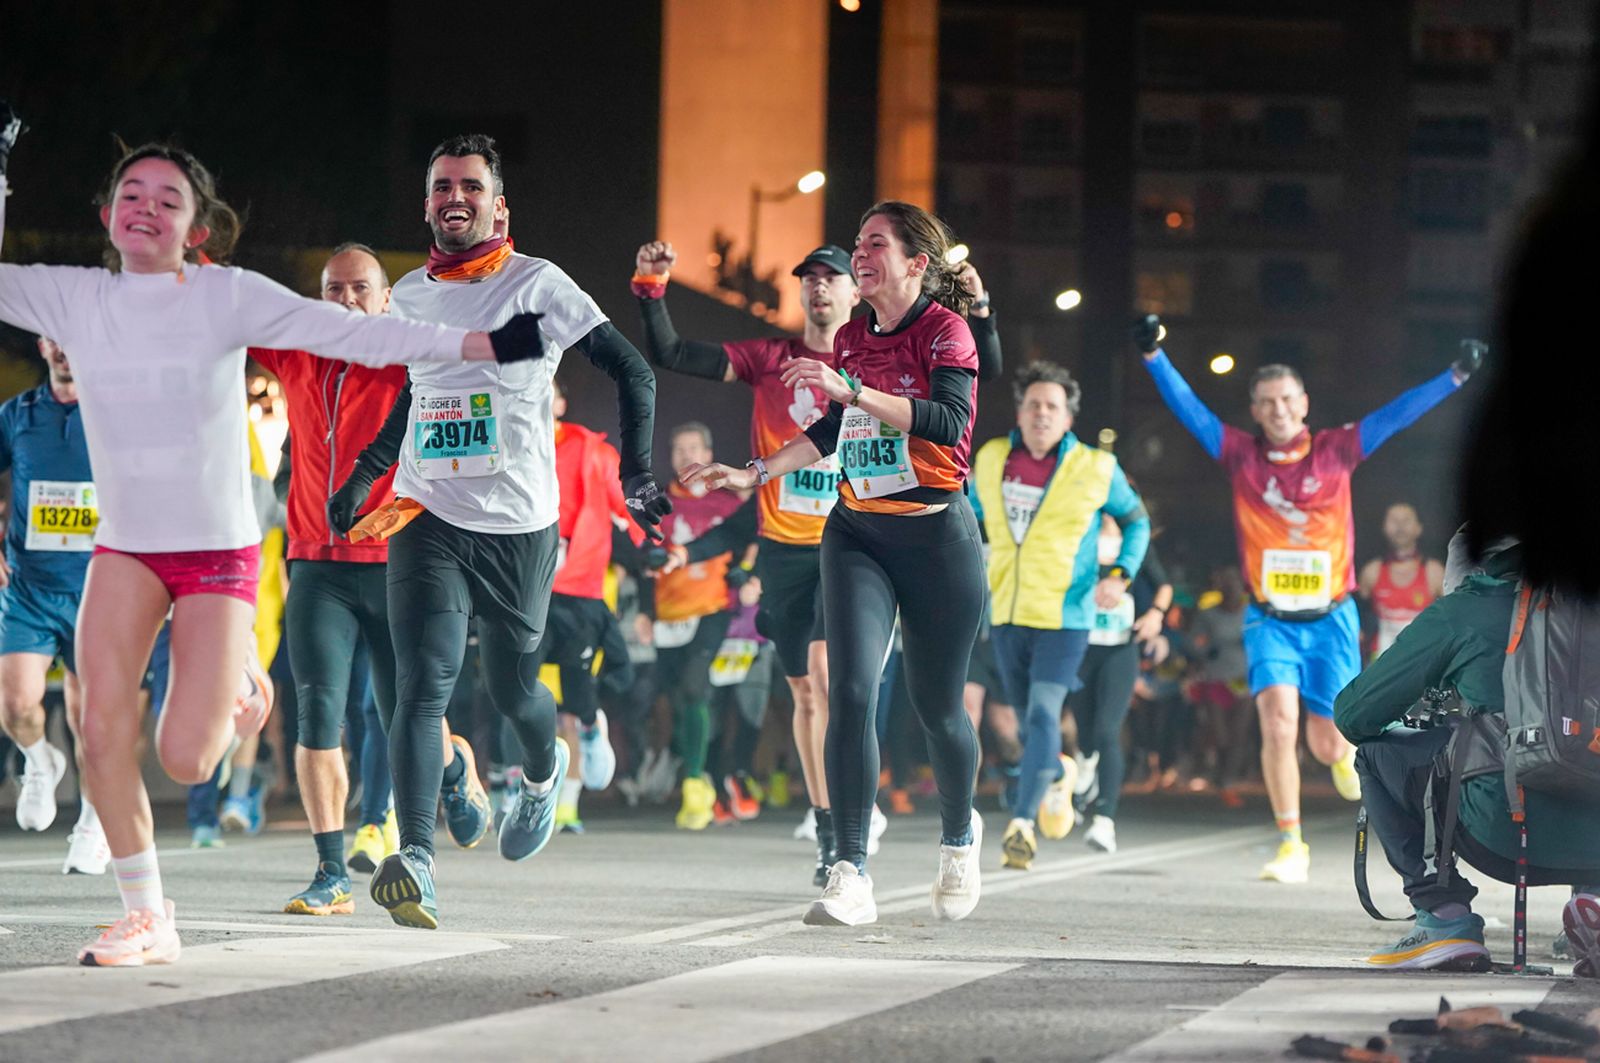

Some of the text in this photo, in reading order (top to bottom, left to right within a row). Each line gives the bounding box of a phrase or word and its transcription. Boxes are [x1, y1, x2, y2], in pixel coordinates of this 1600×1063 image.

[451, 400, 462, 409] DE
[420, 411, 433, 420] SAN
[423, 420, 489, 449] 13974
[841, 439, 897, 469] 13643
[39, 507, 92, 527] 13278
[1274, 573, 1320, 590] 13019
[1394, 929, 1428, 949] HOKA
